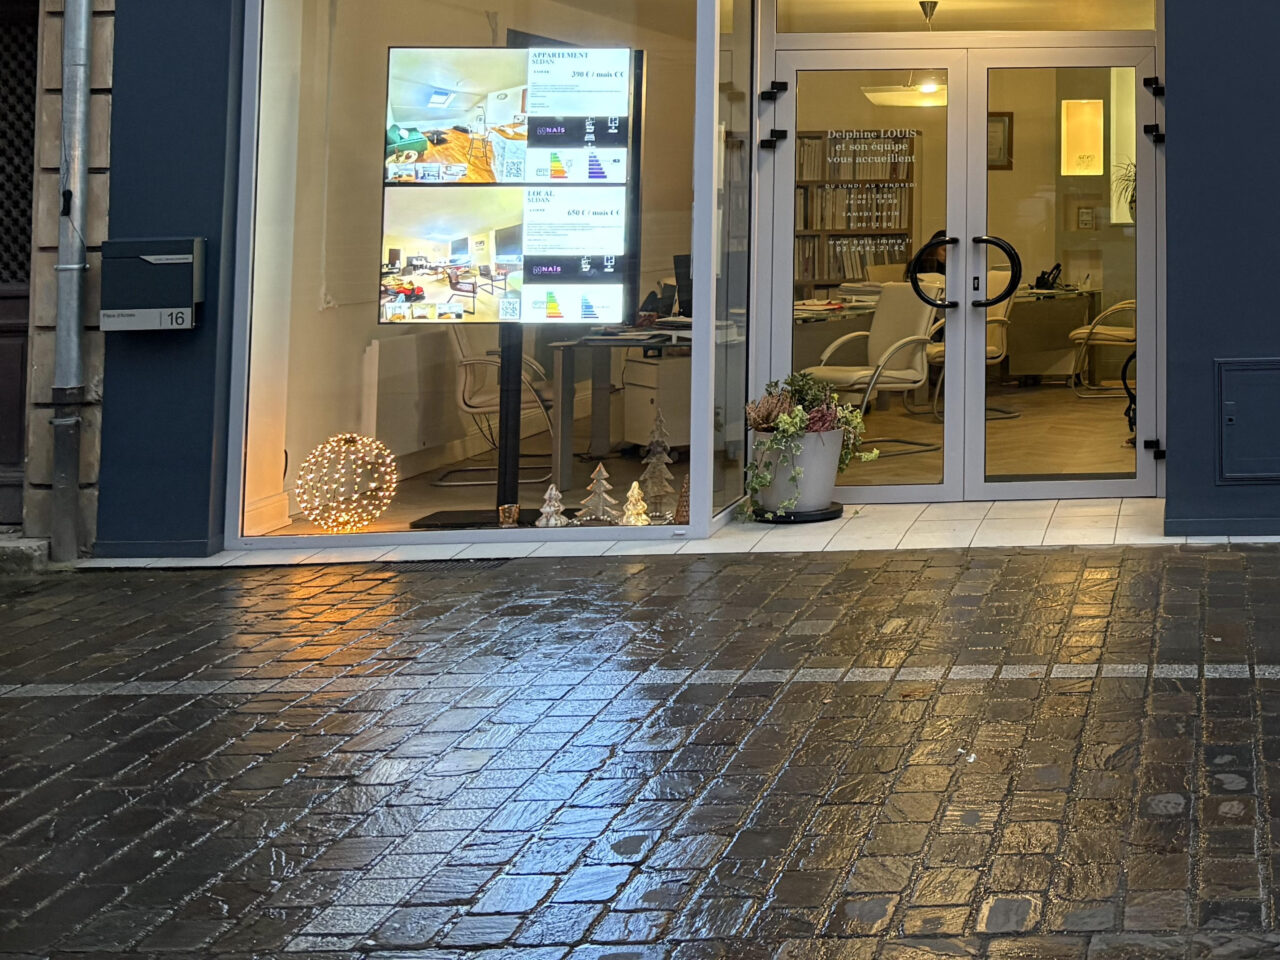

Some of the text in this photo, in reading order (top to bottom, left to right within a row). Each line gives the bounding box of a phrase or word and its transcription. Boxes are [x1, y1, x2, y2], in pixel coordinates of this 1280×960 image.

[827, 128, 917, 140] Delphine LOUIS
[835, 143, 846, 151] et
[871, 141, 909, 153] équipe
[855, 153, 916, 163] accueillent
[167, 311, 185, 326] 16
